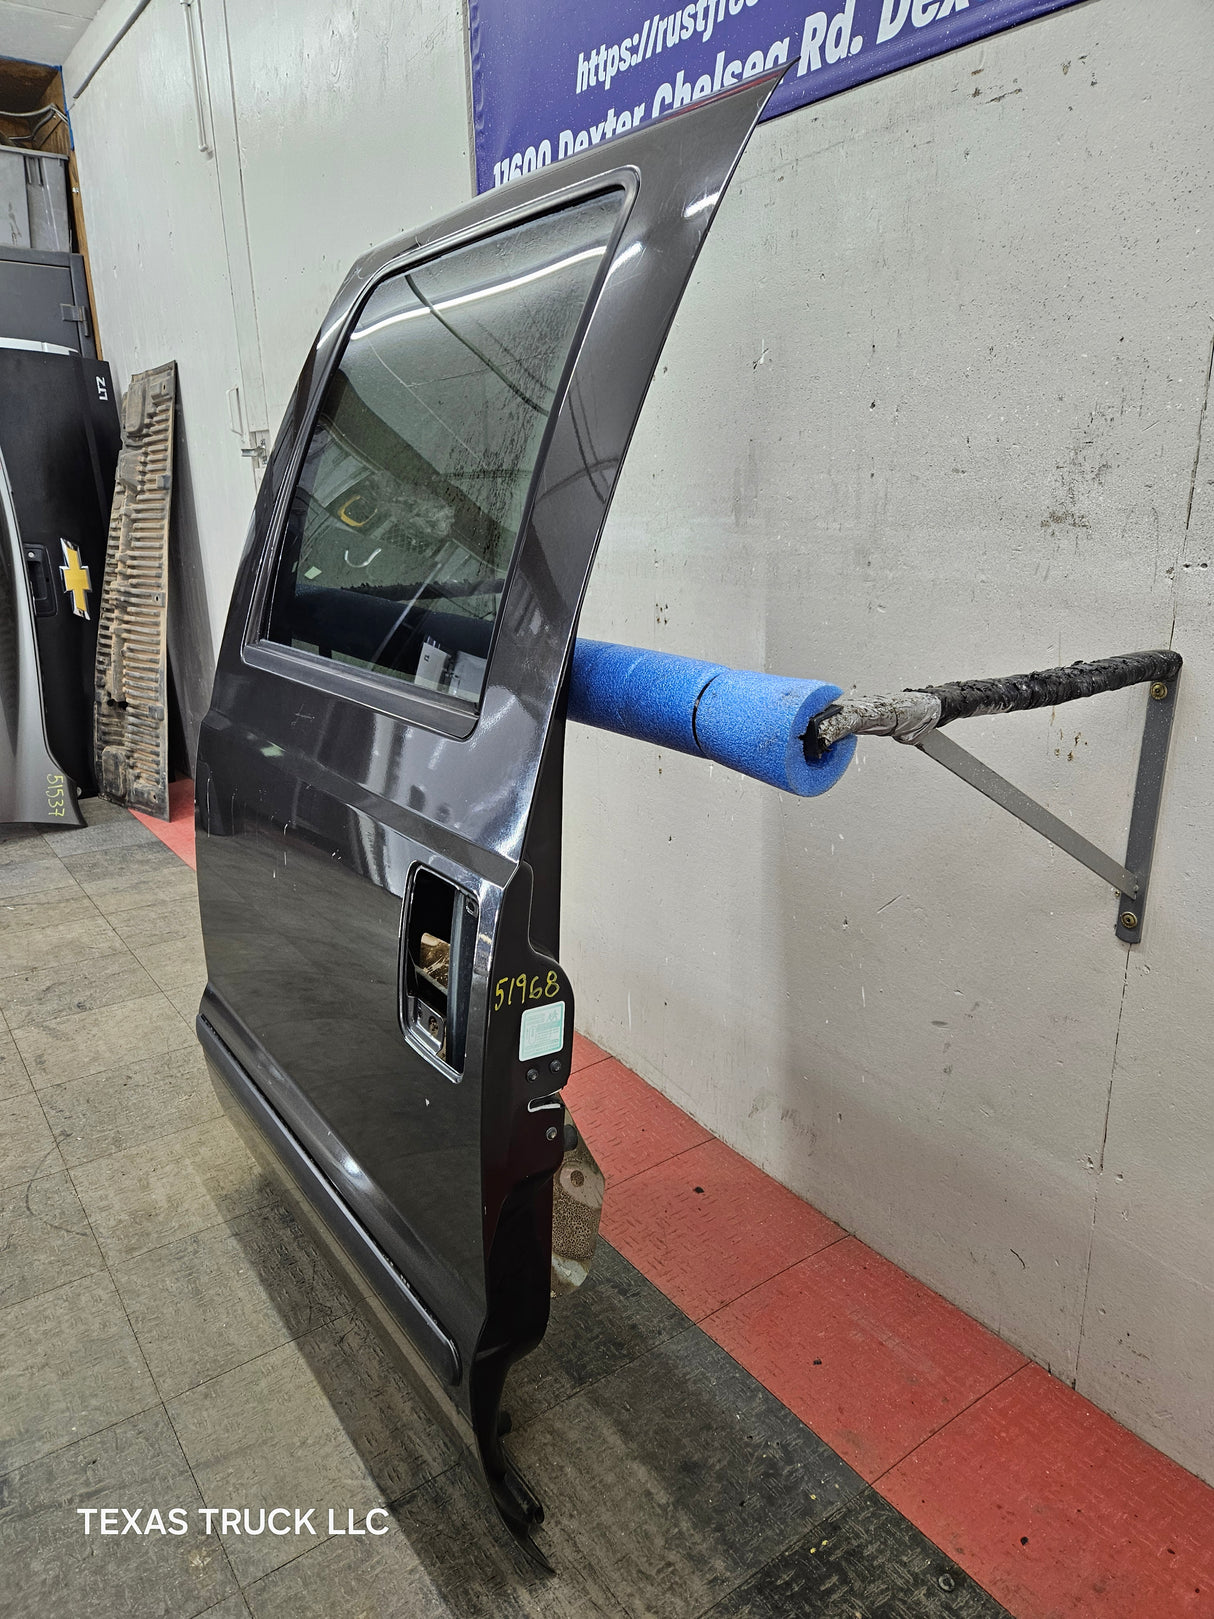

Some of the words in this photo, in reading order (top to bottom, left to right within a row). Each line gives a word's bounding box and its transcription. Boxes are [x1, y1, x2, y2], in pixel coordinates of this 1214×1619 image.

[797, 0, 863, 77] Rd.
[95, 376, 109, 401] LTZ
[45, 773, 65, 817] 51537
[494, 970, 560, 1011] 51968
